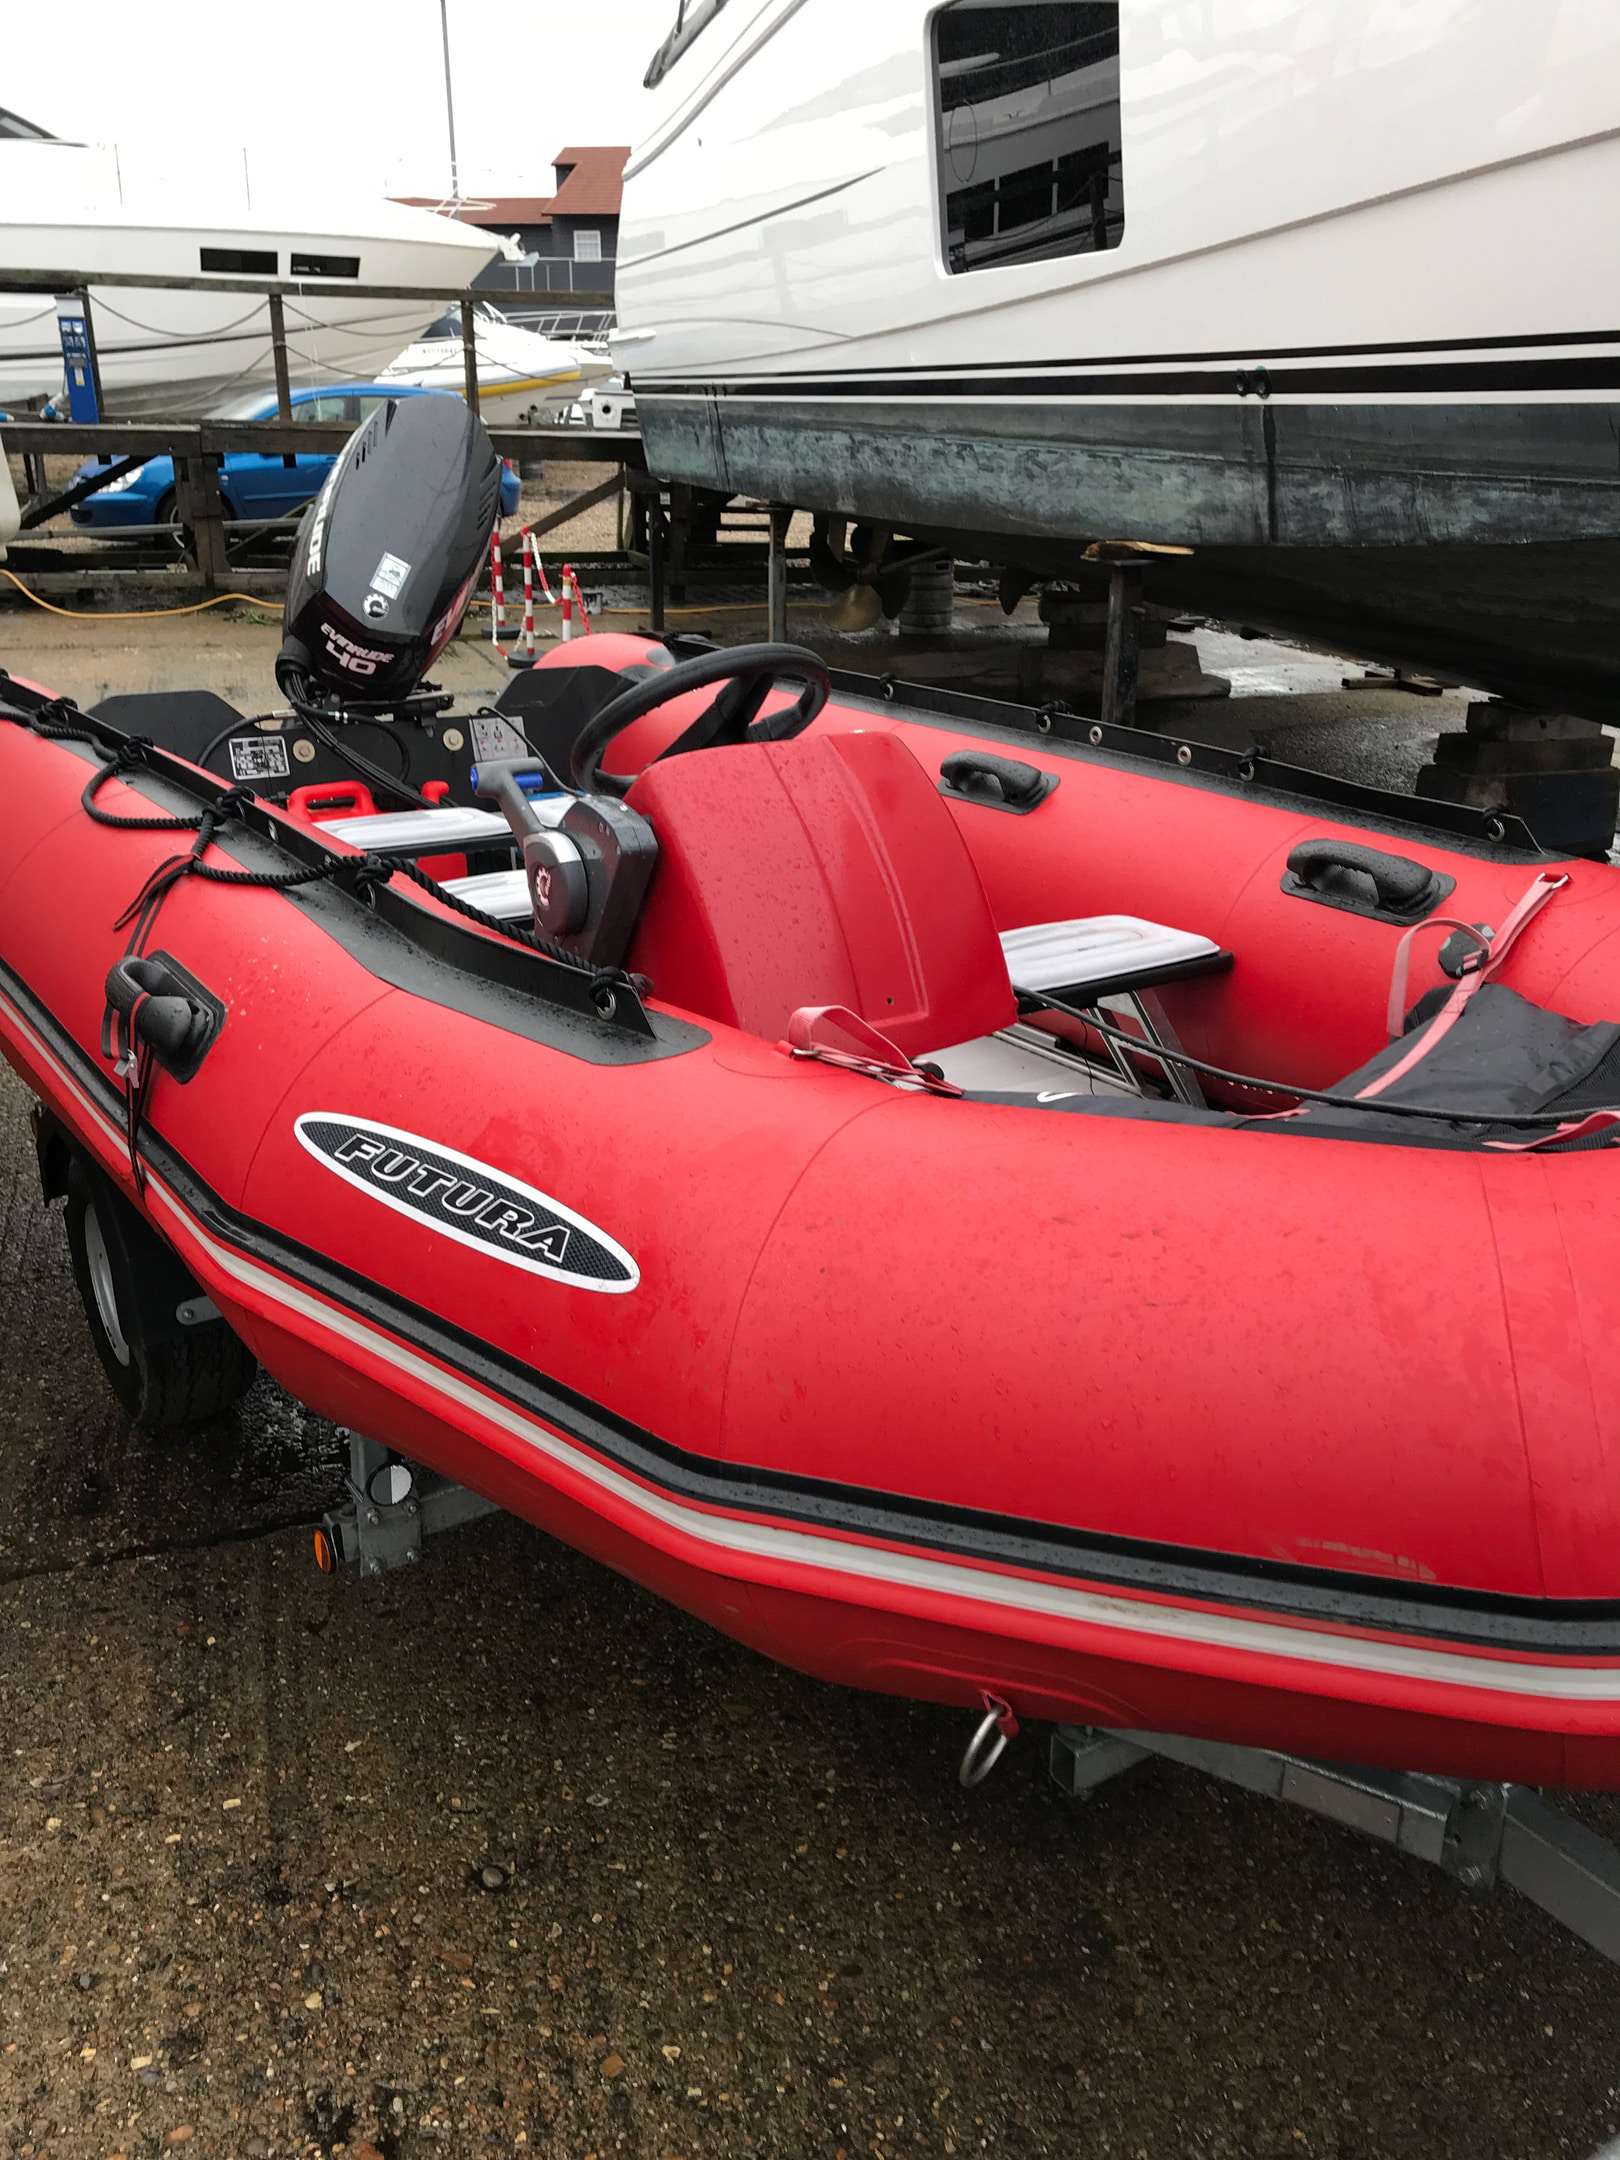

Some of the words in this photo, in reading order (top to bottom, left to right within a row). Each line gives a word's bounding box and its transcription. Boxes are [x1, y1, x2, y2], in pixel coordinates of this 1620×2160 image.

[320, 622, 395, 663] EVINRUDE
[325, 640, 376, 675] 40
[334, 1134, 571, 1264] FUTURA
